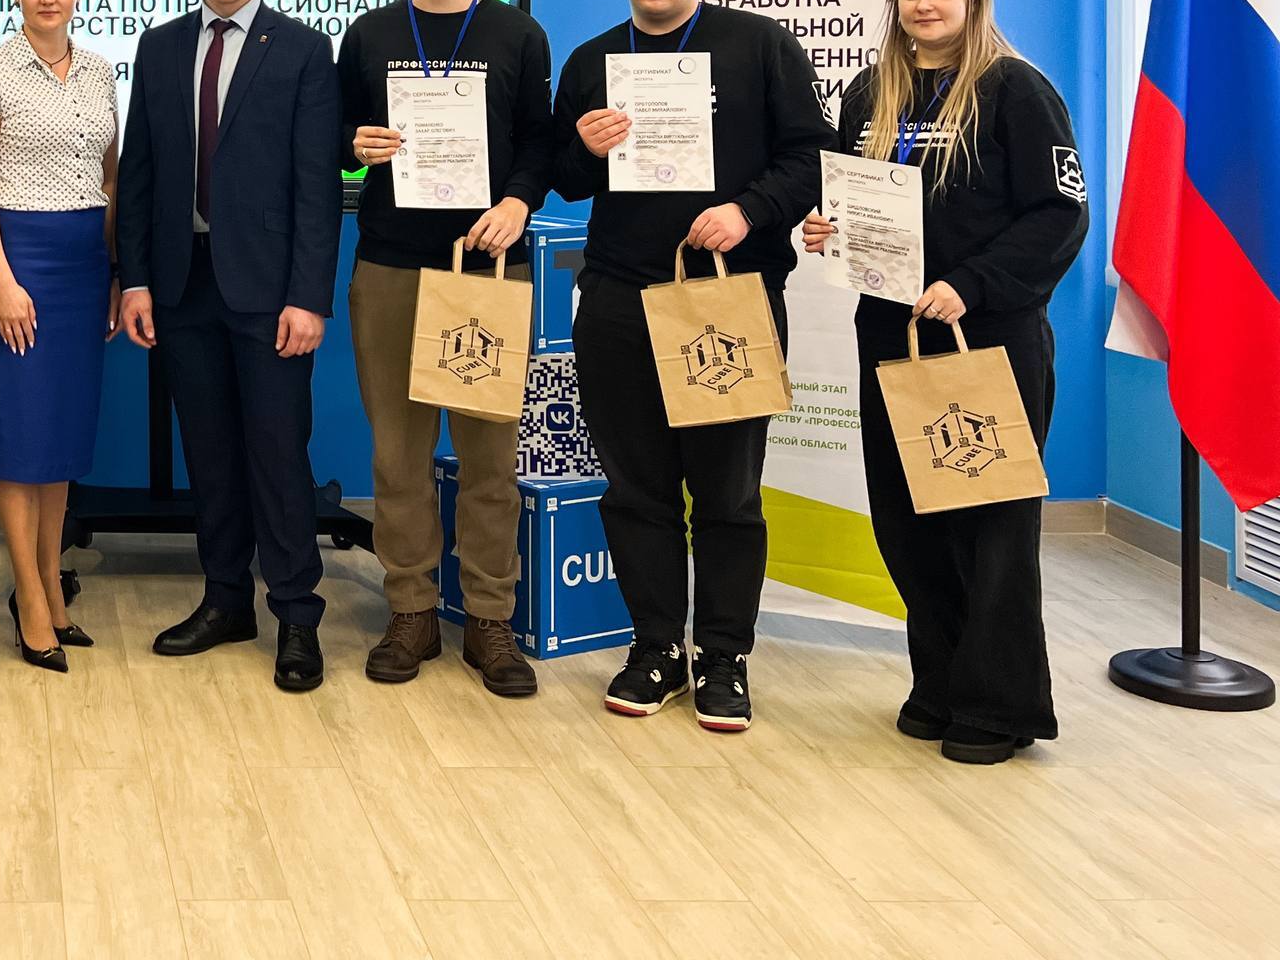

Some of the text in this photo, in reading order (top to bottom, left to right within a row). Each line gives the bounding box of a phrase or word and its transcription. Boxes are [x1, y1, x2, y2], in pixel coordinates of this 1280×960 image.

[632, 68, 672, 76] СЕРТИФИКАТ
[455, 360, 482, 374] CUBE
[706, 366, 733, 385] CUBE
[821, 384, 848, 395] ЭТАП
[550, 410, 570, 425] VK
[807, 405, 822, 415] ПО
[767, 435, 848, 451] НСКОЙ ОБЛАСТИ
[954, 447, 982, 468] CUBE
[561, 551, 615, 588] CU
